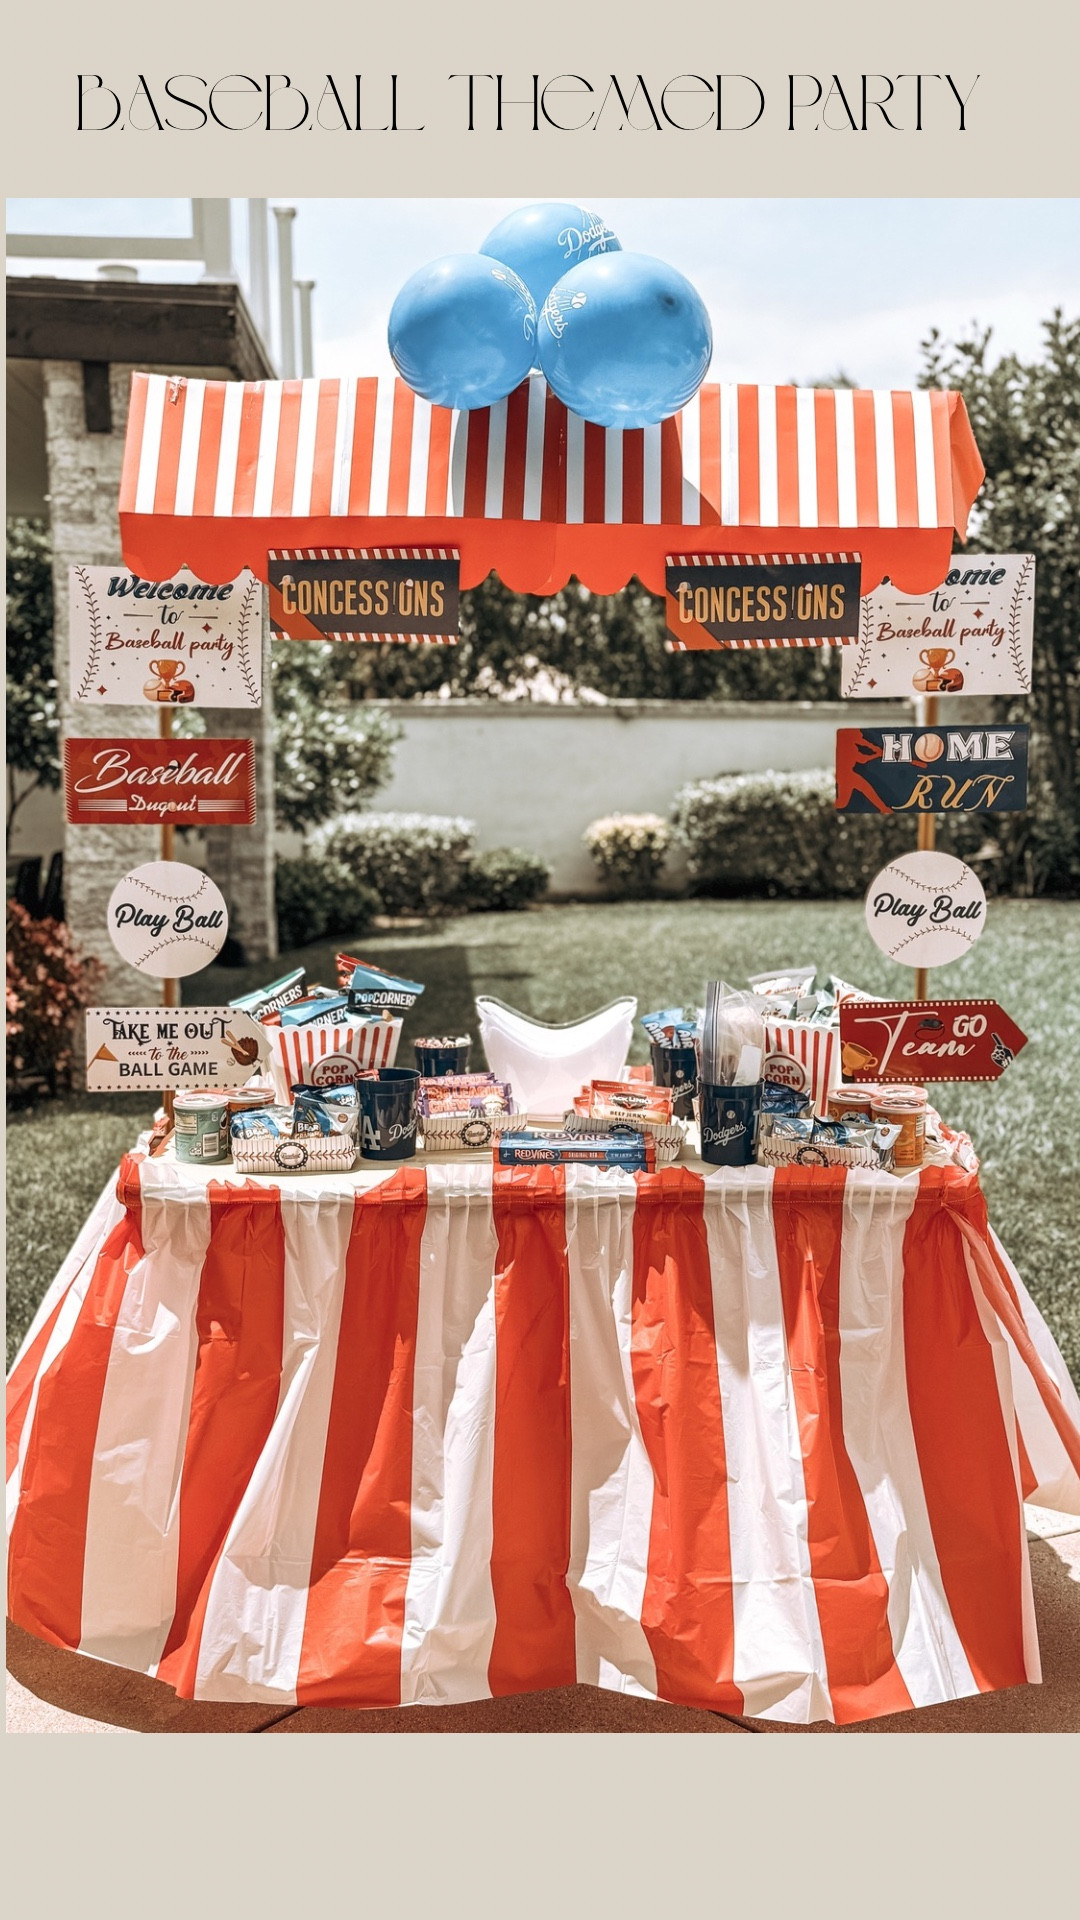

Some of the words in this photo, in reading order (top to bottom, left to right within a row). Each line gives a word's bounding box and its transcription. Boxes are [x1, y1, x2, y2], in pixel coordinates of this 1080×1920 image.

[107, 574, 235, 600] Welcome
[929, 591, 957, 612] to
[157, 604, 185, 625] to
[876, 616, 957, 641] Baseball
[959, 618, 1006, 647] party
[104, 628, 186, 651] Baseball
[189, 633, 235, 661] party
[881, 731, 1016, 763] HOME
[74, 748, 247, 793] Baseball
[891, 774, 1015, 812] RUN
[128, 794, 197, 818] Dugout
[115, 903, 170, 938] Play
[172, 904, 224, 934] Ball
[873, 892, 927, 927] Play
[929, 895, 983, 924] Ball
[354, 991, 418, 1008] POPCORNERS
[103, 1017, 152, 1046] TAKE
[157, 1023, 178, 1040] ME
[184, 1016, 233, 1040] OUT
[952, 1014, 988, 1038] GO
[148, 1047, 163, 1061] to
[167, 1046, 189, 1061] the
[853, 1011, 976, 1076] Team
[119, 1062, 164, 1077] BALL
[168, 1062, 218, 1077] GAME
[316, 1075, 355, 1086] CORN
[322, 1064, 349, 1075] POP
[764, 1073, 801, 1086] CORN
[769, 1064, 794, 1075] POP
[429, 1099, 471, 1114] CHEW
[703, 1120, 747, 1146] Dodgers
